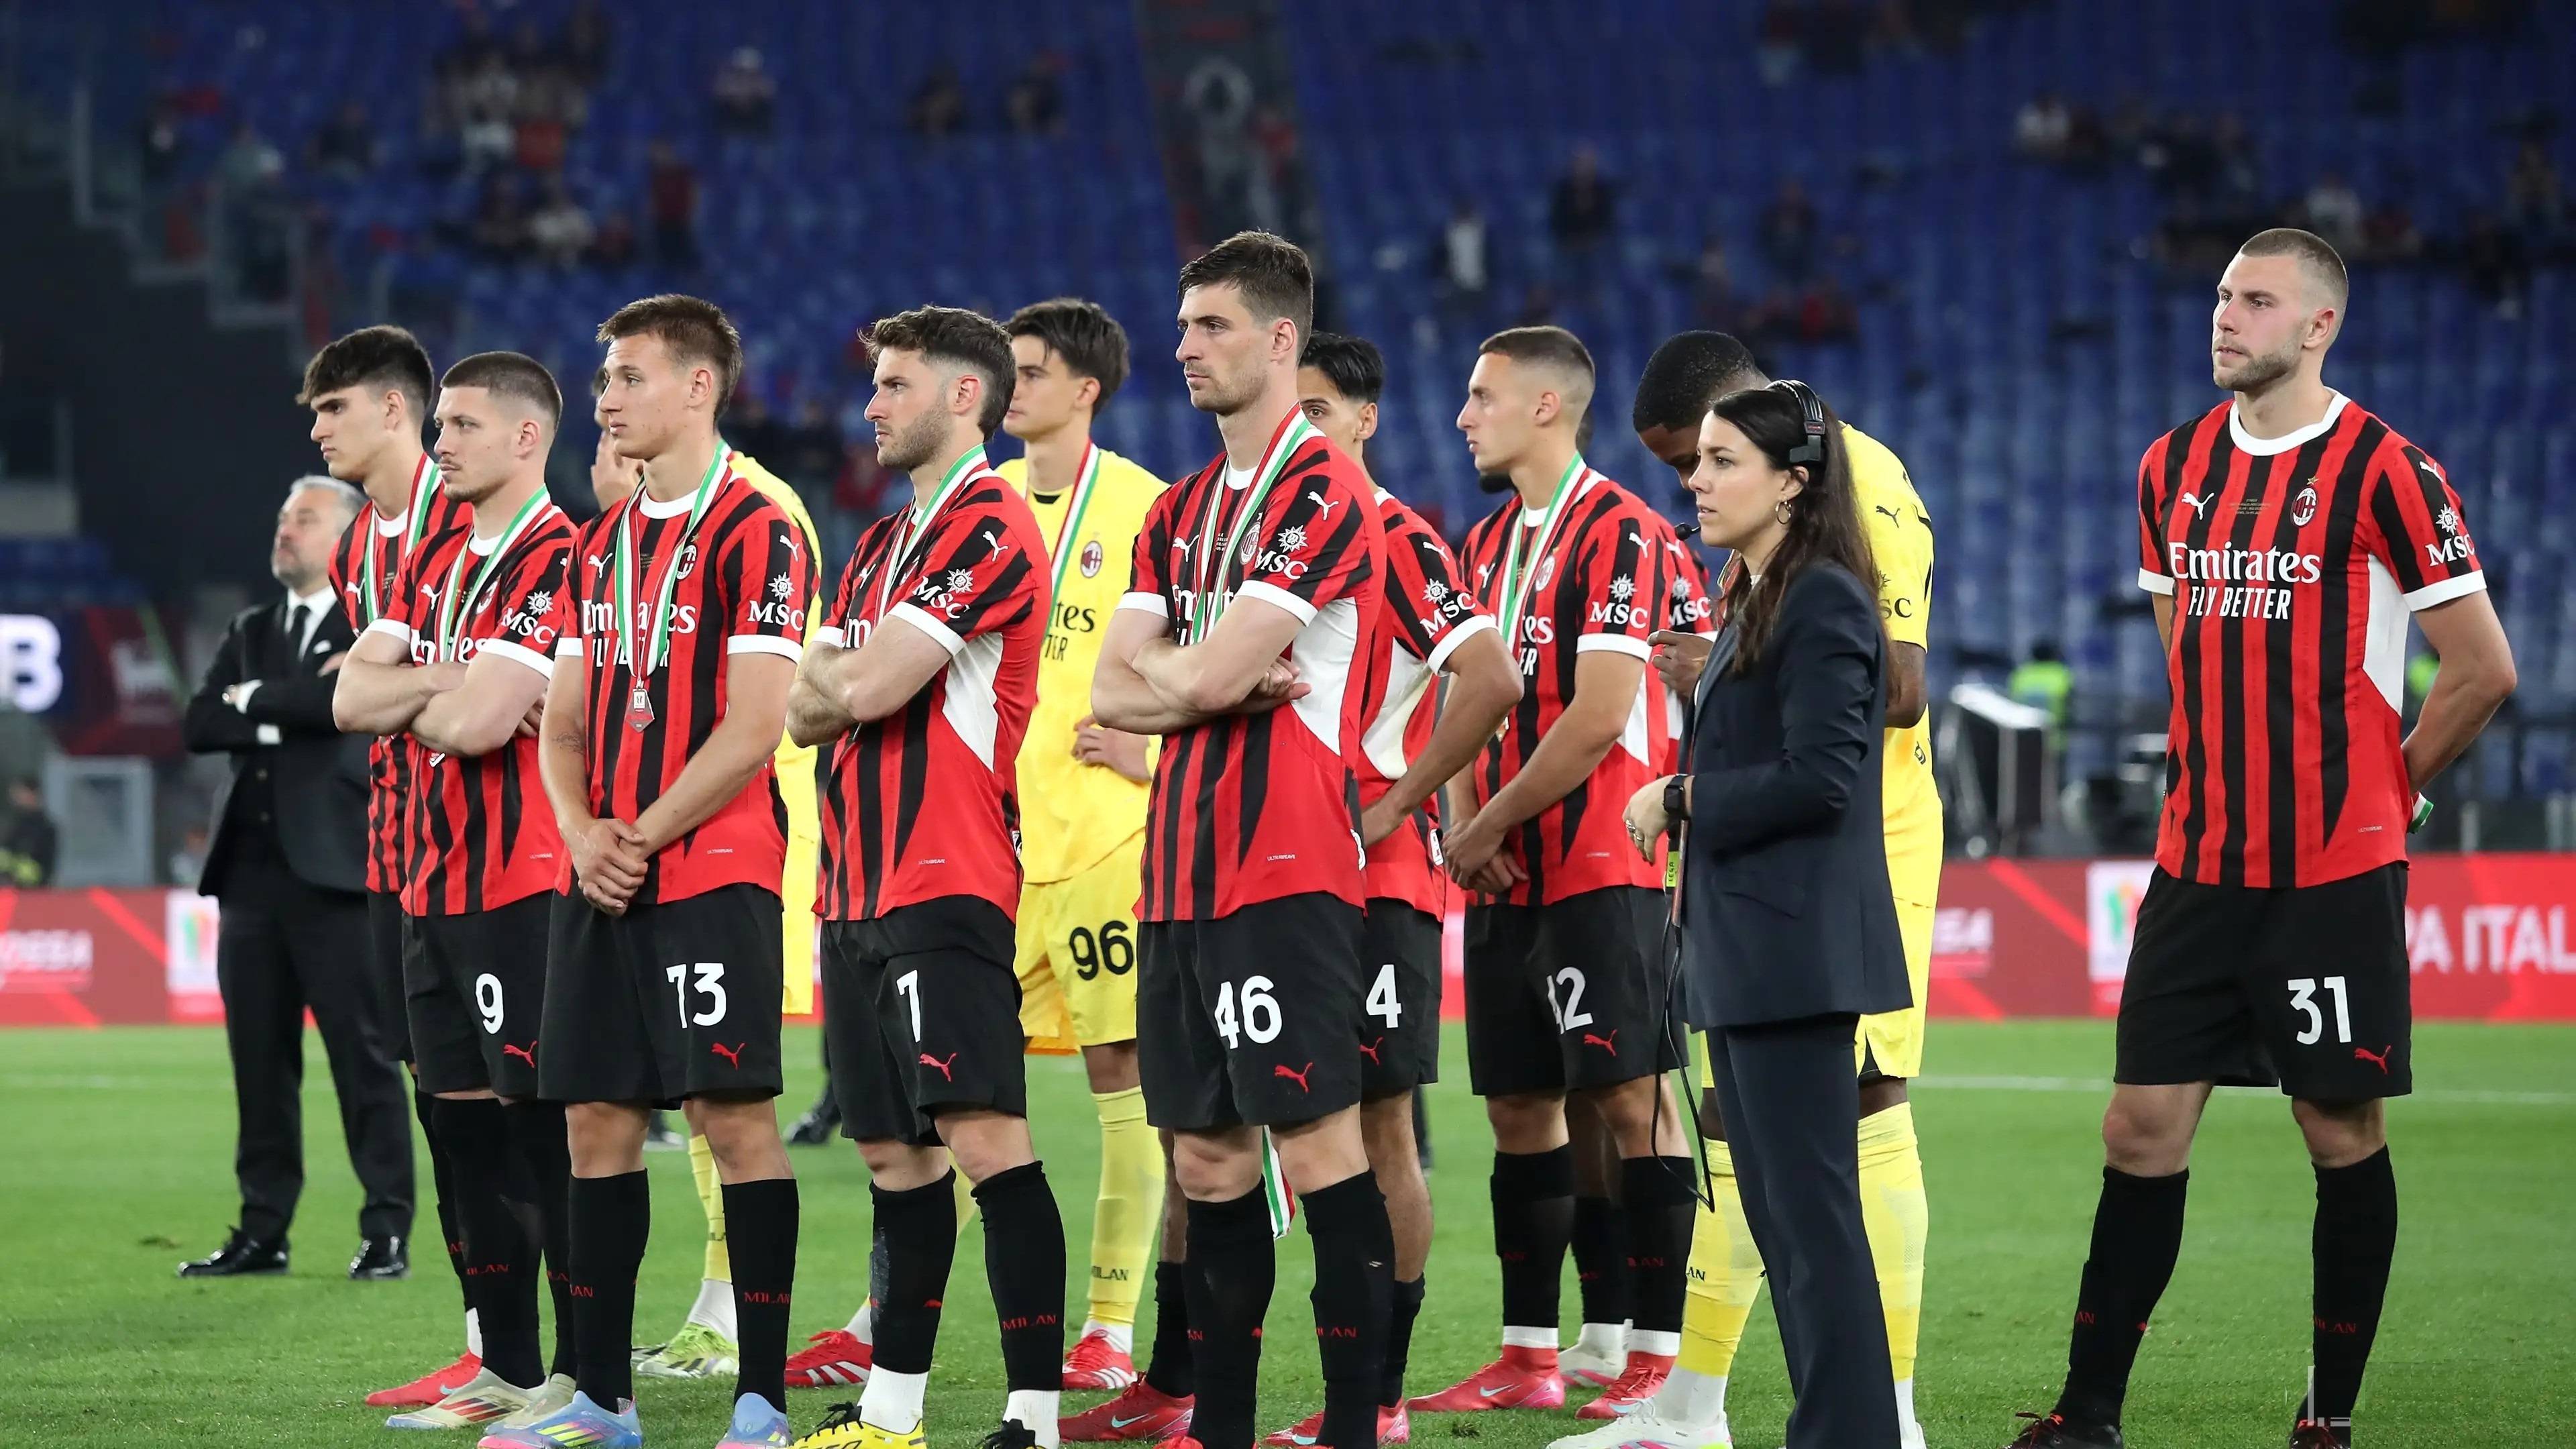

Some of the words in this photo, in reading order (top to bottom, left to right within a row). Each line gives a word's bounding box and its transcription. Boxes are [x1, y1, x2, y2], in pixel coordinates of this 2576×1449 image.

[1254, 547, 1309, 580] MSC
[2168, 541, 2321, 584] Emirates
[2425, 533, 2475, 566] MSC
[747, 600, 804, 631] MSC
[912, 575, 970, 619] MSC
[1419, 592, 1476, 639] MSC
[1589, 601, 1648, 629] MSC
[1669, 596, 1711, 627] MSC
[2188, 586, 2217, 616] FLY
[2219, 587, 2292, 620] BETTER
[502, 607, 556, 644] MSC
[1069, 920, 1134, 981] 96
[2463, 904, 2576, 975] ITAL
[475, 973, 504, 1034] 9
[665, 962, 727, 1028] 73
[897, 970, 921, 1042] 7
[1215, 975, 1283, 1050] 46
[2288, 975, 2352, 1044] 31
